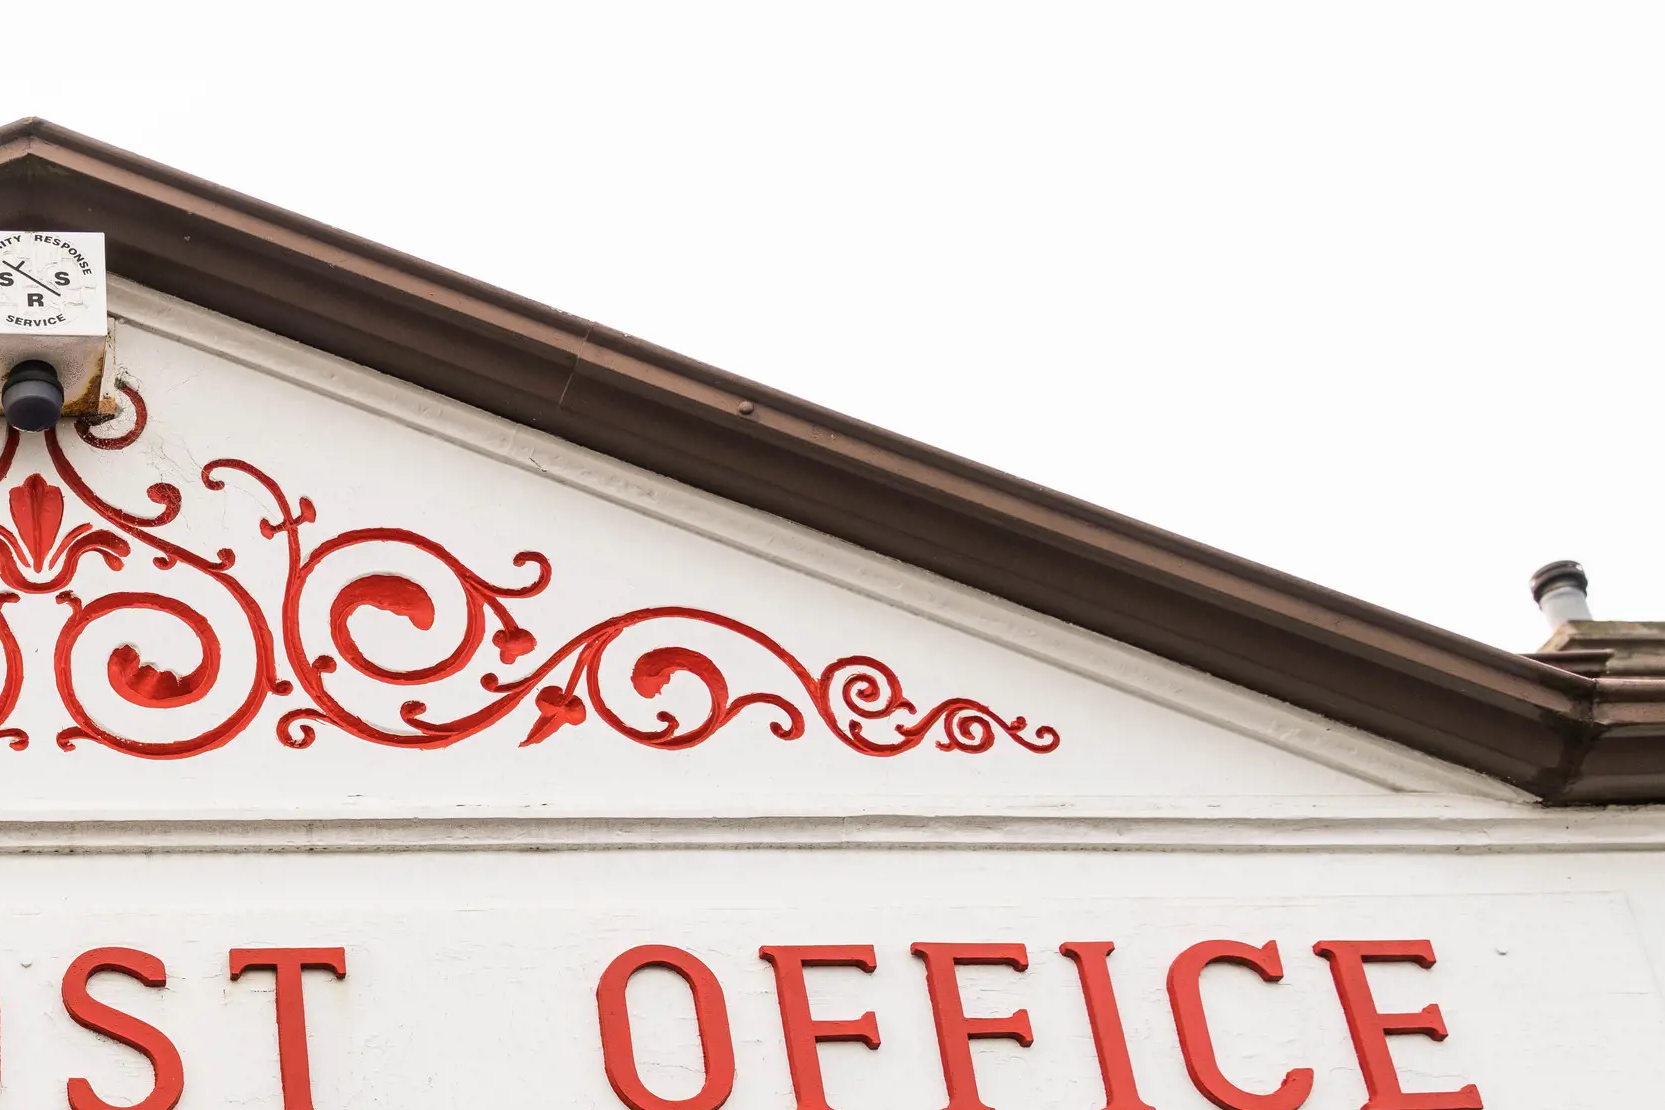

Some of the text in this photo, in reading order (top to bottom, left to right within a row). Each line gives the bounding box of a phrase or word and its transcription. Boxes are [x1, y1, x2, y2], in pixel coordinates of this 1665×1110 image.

[34, 234, 92, 275] RESPONSE
[54, 271, 70, 286] S
[27, 293, 44, 307] R
[6, 313, 66, 327] SERVICE
